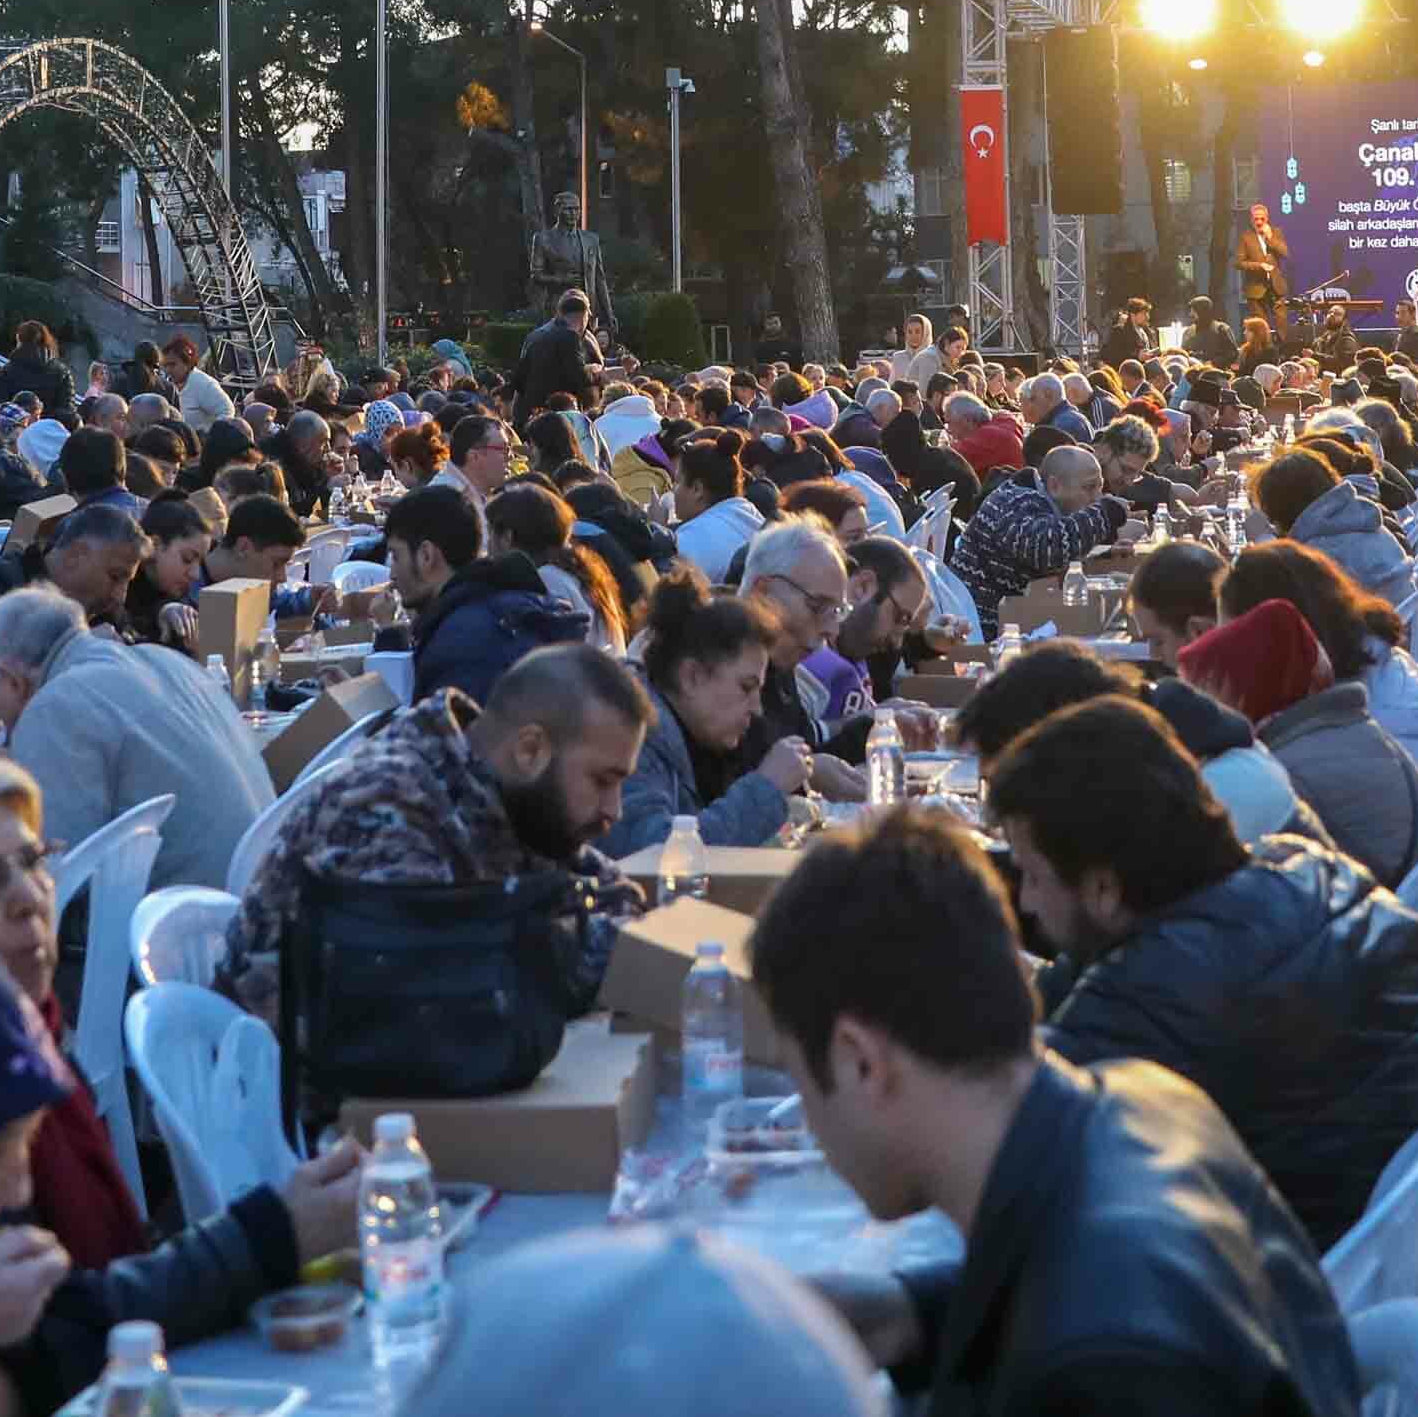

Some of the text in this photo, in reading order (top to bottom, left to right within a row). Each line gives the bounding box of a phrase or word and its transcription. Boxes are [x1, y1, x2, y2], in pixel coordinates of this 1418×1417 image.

[1371, 119, 1399, 134] Şanlı
[1372, 167, 1415, 187] 109.
[1338, 201, 1371, 214] başta
[1374, 199, 1410, 213] Büyük
[1328, 219, 1354, 231] silah
[1349, 237, 1364, 249] bir
[1367, 237, 1388, 248] kez
